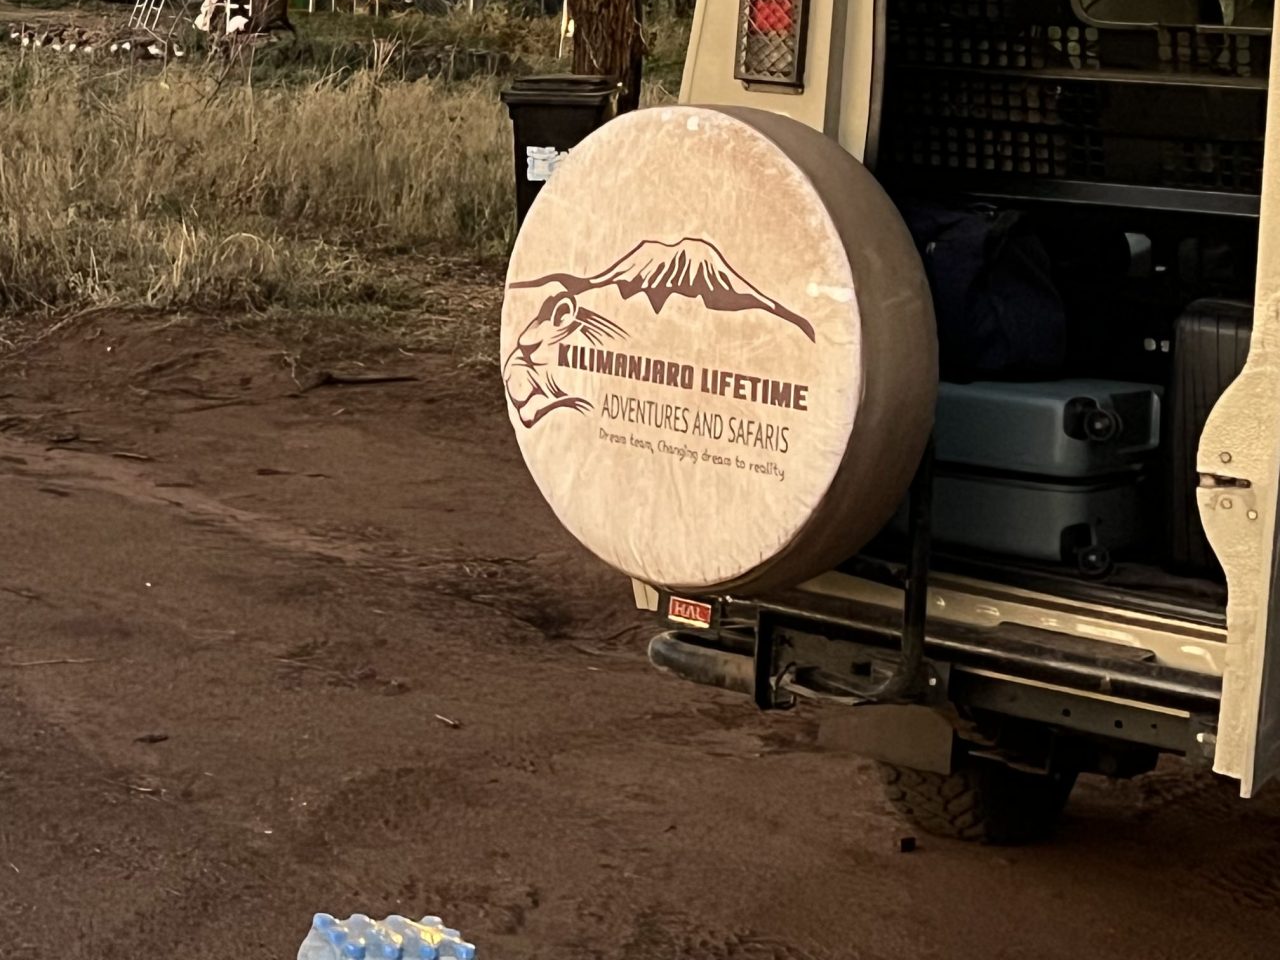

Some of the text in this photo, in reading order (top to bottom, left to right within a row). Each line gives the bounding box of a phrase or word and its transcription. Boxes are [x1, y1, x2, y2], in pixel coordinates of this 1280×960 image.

[558, 342, 809, 412] KILIMANJARO LIFETIME
[601, 393, 790, 454] ADVENTURES AND SAFARIS
[735, 455, 746, 470] to
[749, 462, 786, 482] reality
